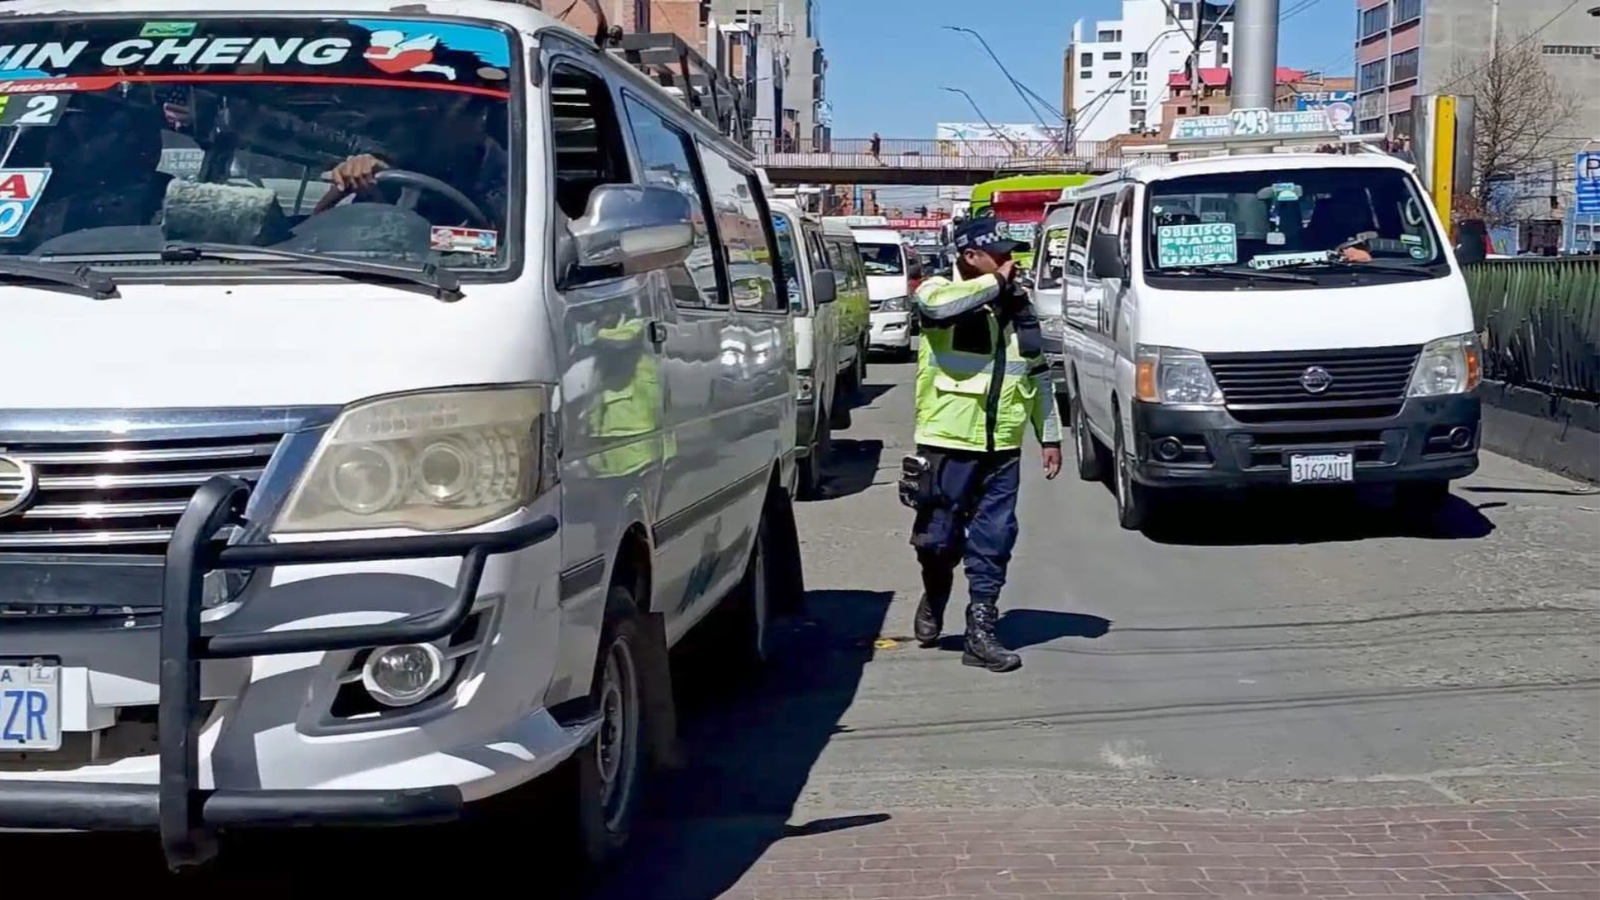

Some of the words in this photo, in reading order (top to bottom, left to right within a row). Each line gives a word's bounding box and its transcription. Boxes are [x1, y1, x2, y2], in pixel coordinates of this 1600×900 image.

[101, 37, 352, 67] CHENG
[18, 95, 59, 124] 2
[1233, 110, 1269, 135] 293
[1161, 225, 1233, 237] OBELISCO
[1162, 235, 1233, 246] PRADO
[1162, 253, 1233, 264] UMSA
